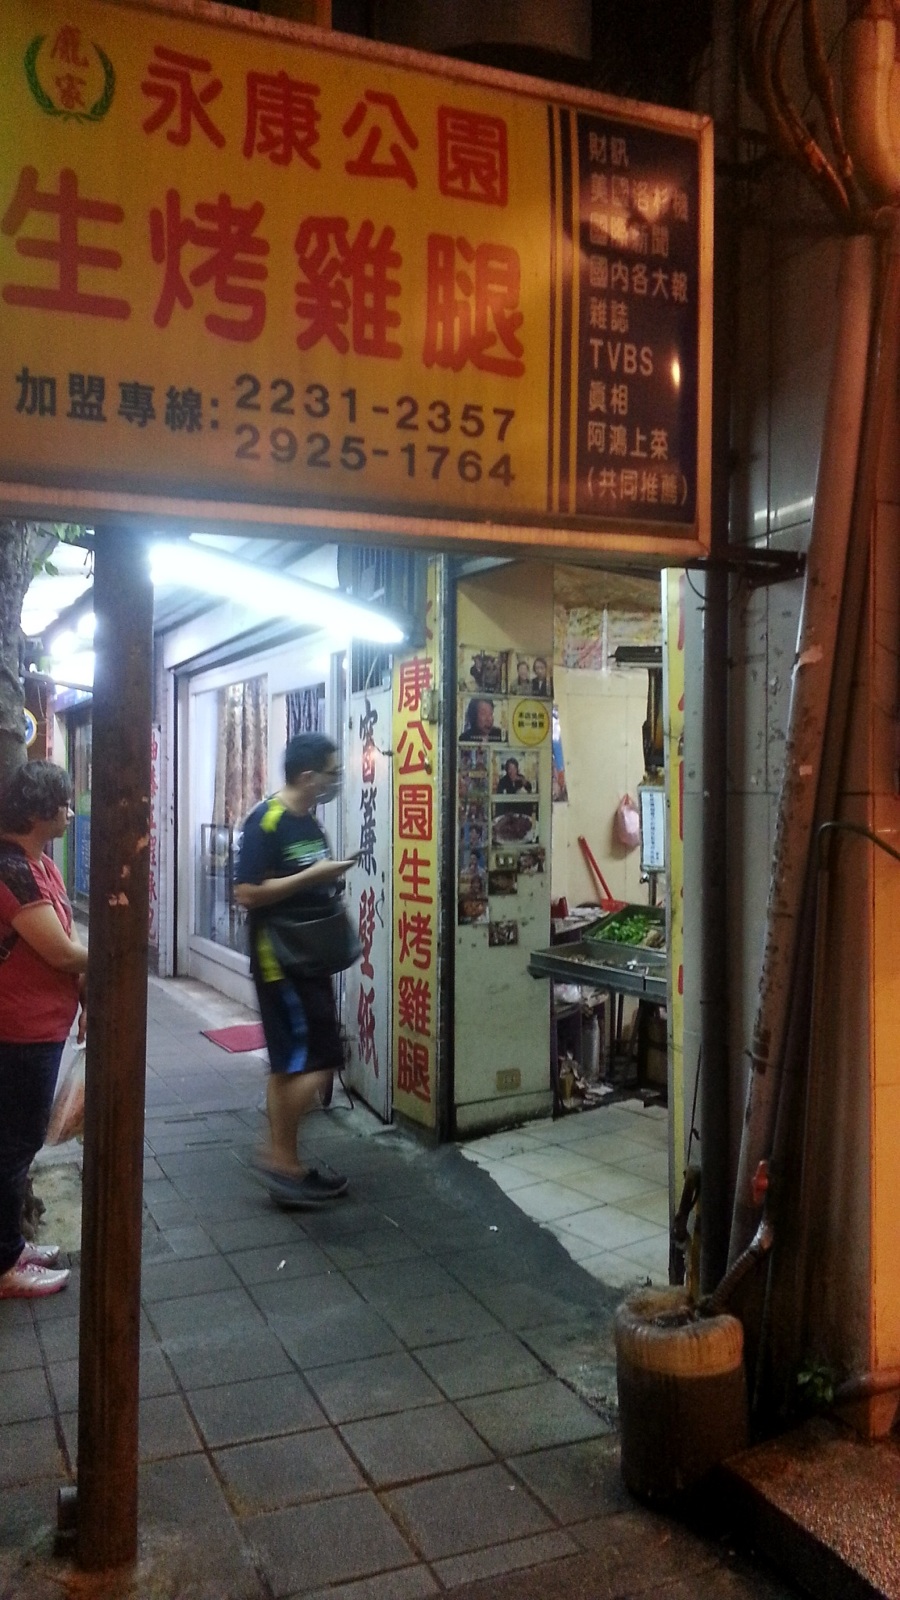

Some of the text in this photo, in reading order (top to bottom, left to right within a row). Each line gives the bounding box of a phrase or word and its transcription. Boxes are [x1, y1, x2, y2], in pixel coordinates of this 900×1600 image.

[141, 45, 509, 208] 永康公園
[0, 165, 524, 379] 生烤雞腿
[589, 255, 688, 303] 國內各大報
[590, 338, 653, 377] TVBS
[235, 373, 517, 442] 2231-2357
[234, 422, 516, 487] 2925-1764
[396, 600, 433, 1103] 康公園生烤雞腿
